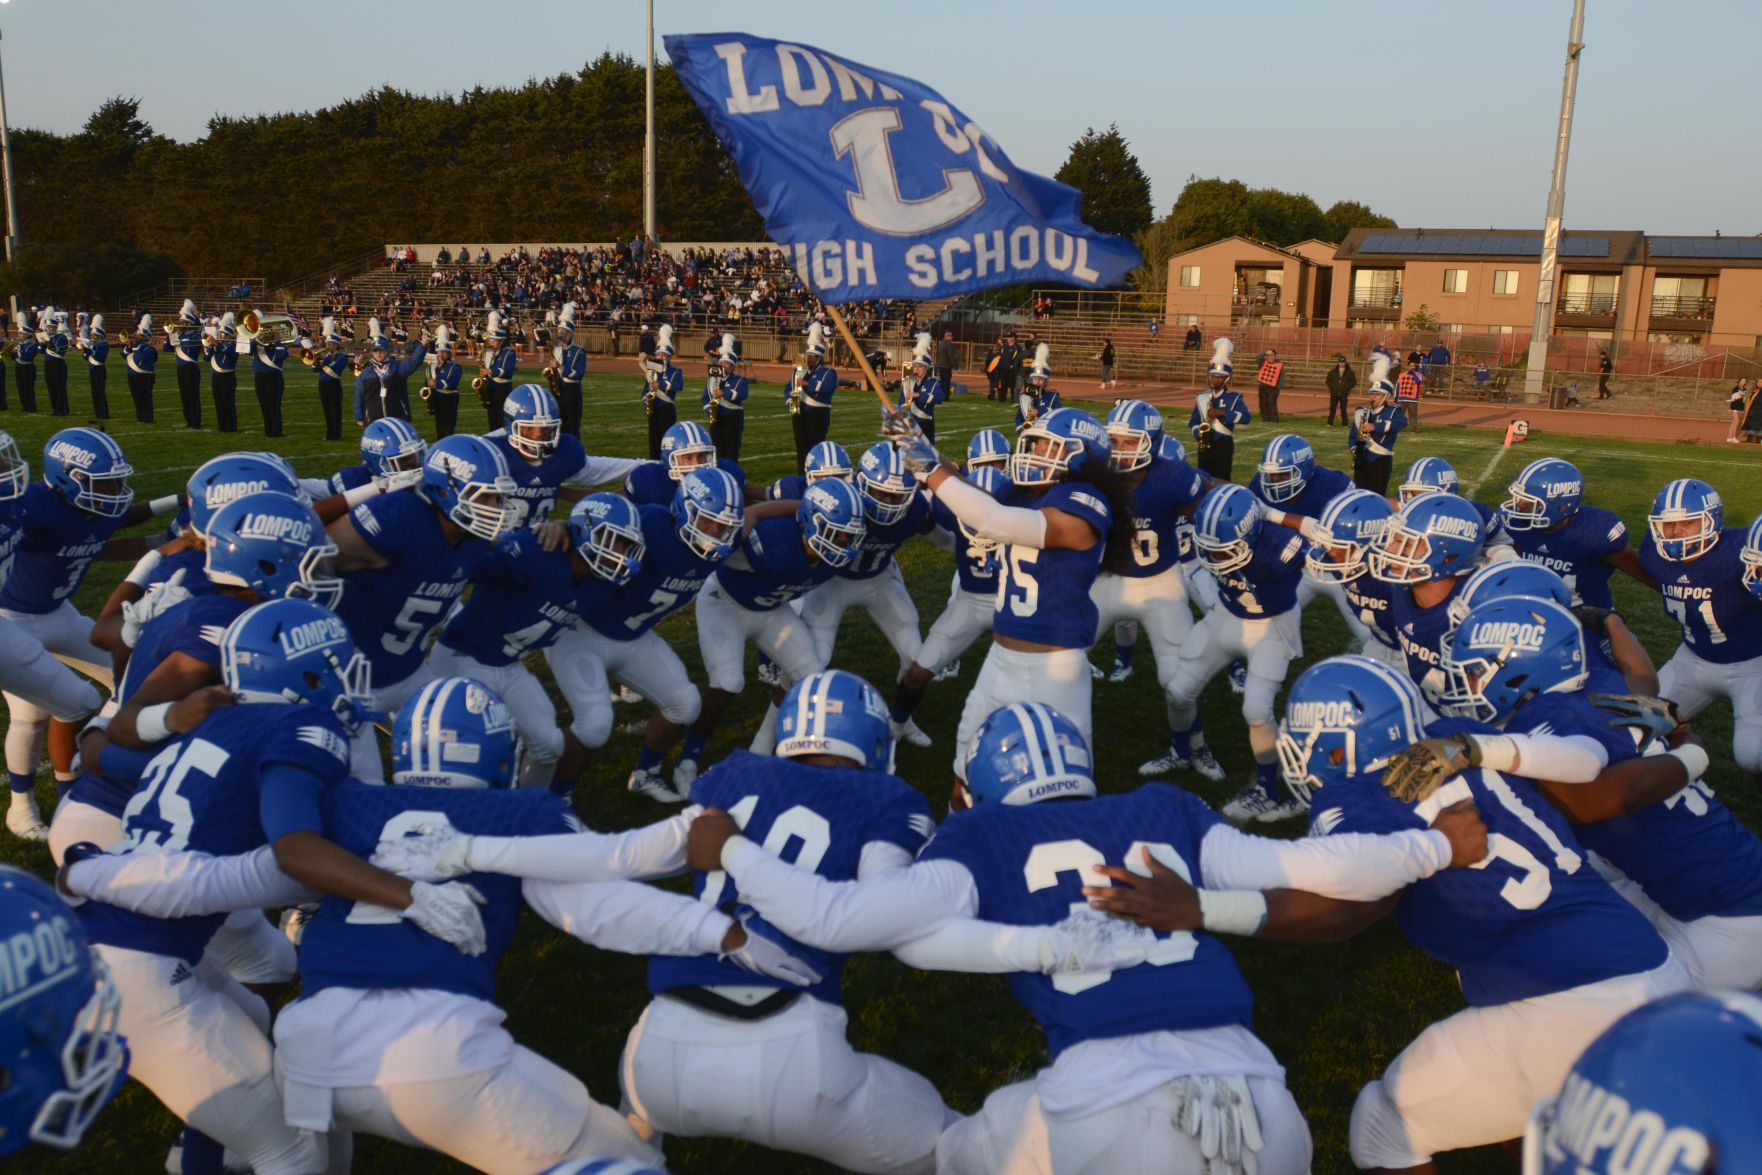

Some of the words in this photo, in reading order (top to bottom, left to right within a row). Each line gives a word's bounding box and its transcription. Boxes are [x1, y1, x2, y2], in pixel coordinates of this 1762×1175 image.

[714, 41, 1008, 182] LOMOC
[830, 106, 985, 236] L
[905, 224, 1099, 287] SCHOOL
[1219, 398, 1227, 408] L
[1513, 420, 1528, 435] G
[48, 440, 97, 468] LOMPOC
[1546, 480, 1581, 498] LOMPOC
[240, 513, 312, 546] LOMPOC
[1428, 513, 1478, 542] LOMPOC
[1661, 584, 1713, 600] LOMPOC
[1665, 597, 1728, 645] 71
[1469, 622, 1546, 651] LOMPOC
[1288, 701, 1351, 731] LOMPOC
[785, 739, 831, 751] LOMPOC
[403, 775, 451, 786] LOMPOC
